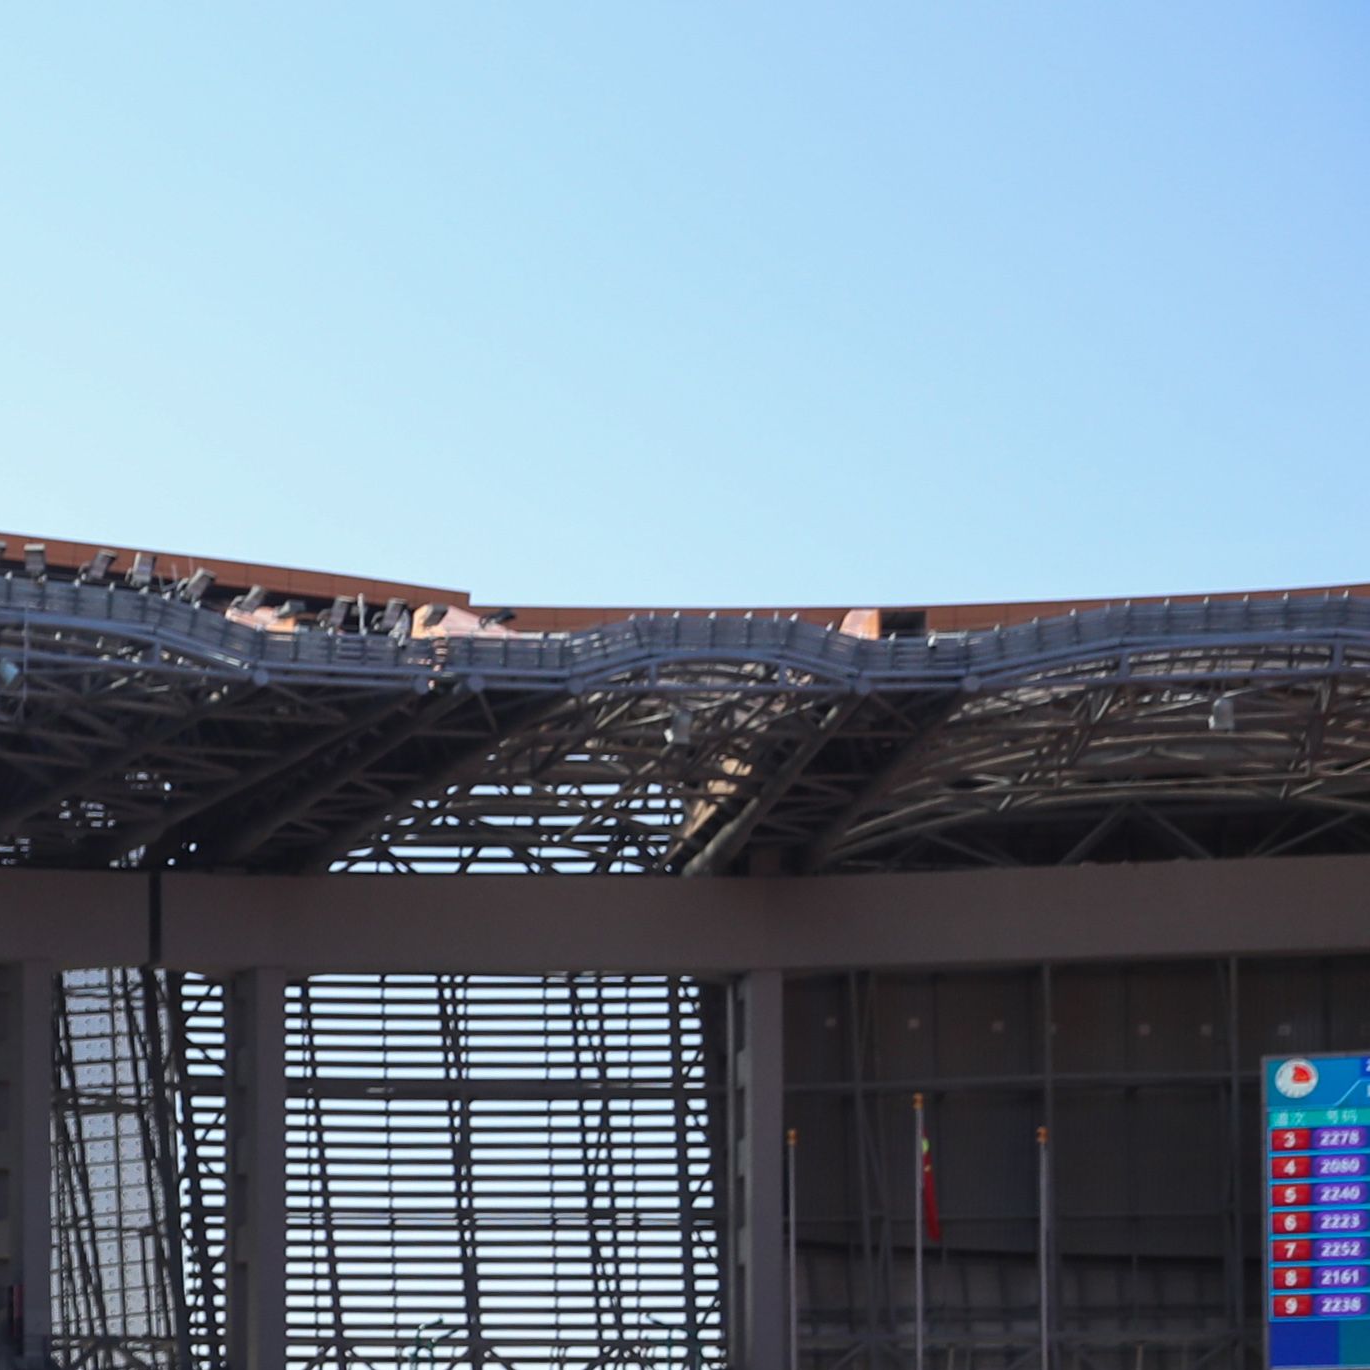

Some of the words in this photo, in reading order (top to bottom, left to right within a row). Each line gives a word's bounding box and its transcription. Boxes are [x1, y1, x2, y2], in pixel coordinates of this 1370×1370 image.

[1283, 1131, 1297, 1148] 3
[1283, 1159, 1297, 1175] 4
[1283, 1187, 1297, 1203] 5
[1283, 1215, 1297, 1231] 6
[1283, 1243, 1297, 1258] 7
[1283, 1270, 1297, 1287] 8
[1283, 1297, 1297, 1314] 9
